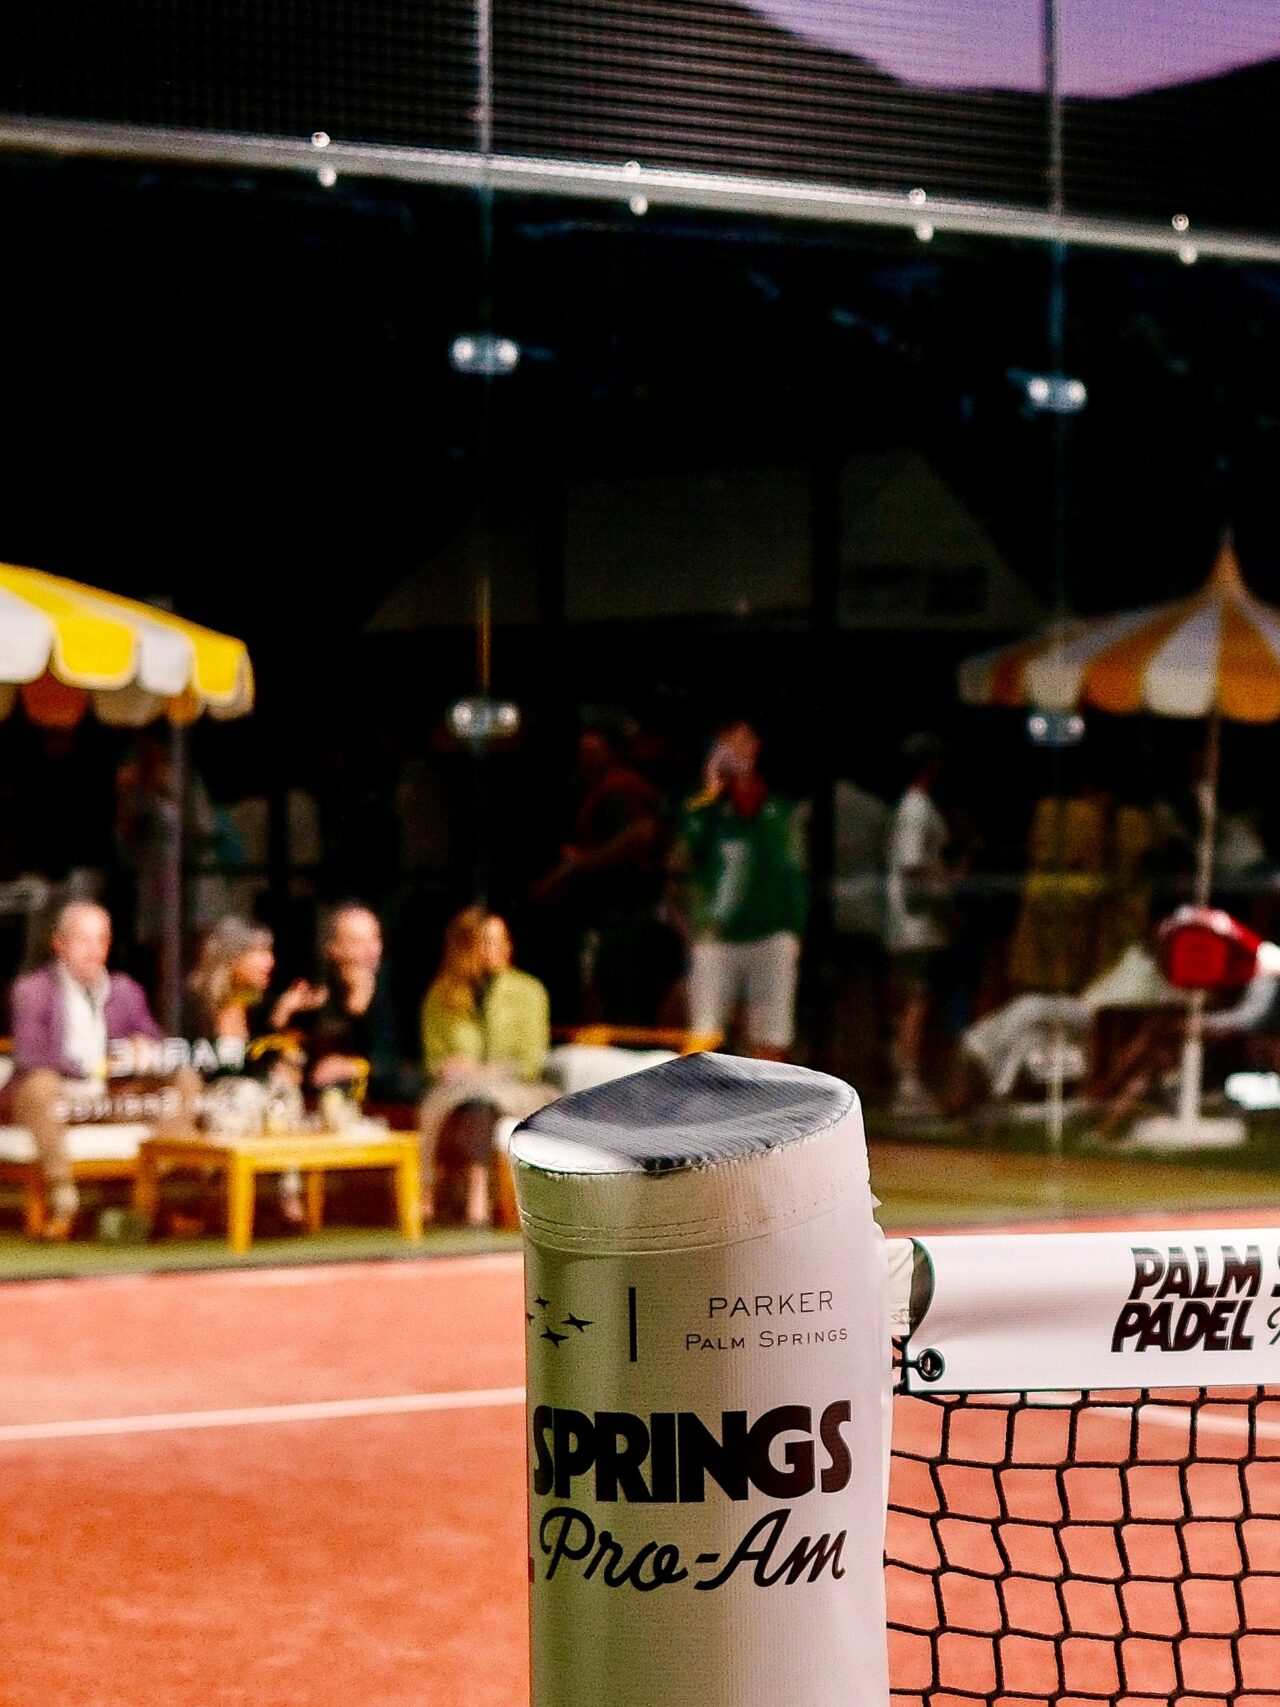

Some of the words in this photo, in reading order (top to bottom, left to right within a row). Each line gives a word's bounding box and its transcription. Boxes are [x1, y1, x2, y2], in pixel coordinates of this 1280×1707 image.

[1127, 1244, 1263, 1300] PALM
[708, 1290, 834, 1318] PARKER
[1110, 1299, 1255, 1352] PADEL
[685, 1333, 746, 1351] PALM
[758, 1328, 849, 1348] SPRINGS
[533, 1399, 853, 1503] SPRINGS
[539, 1506, 848, 1592] Pro-Am
